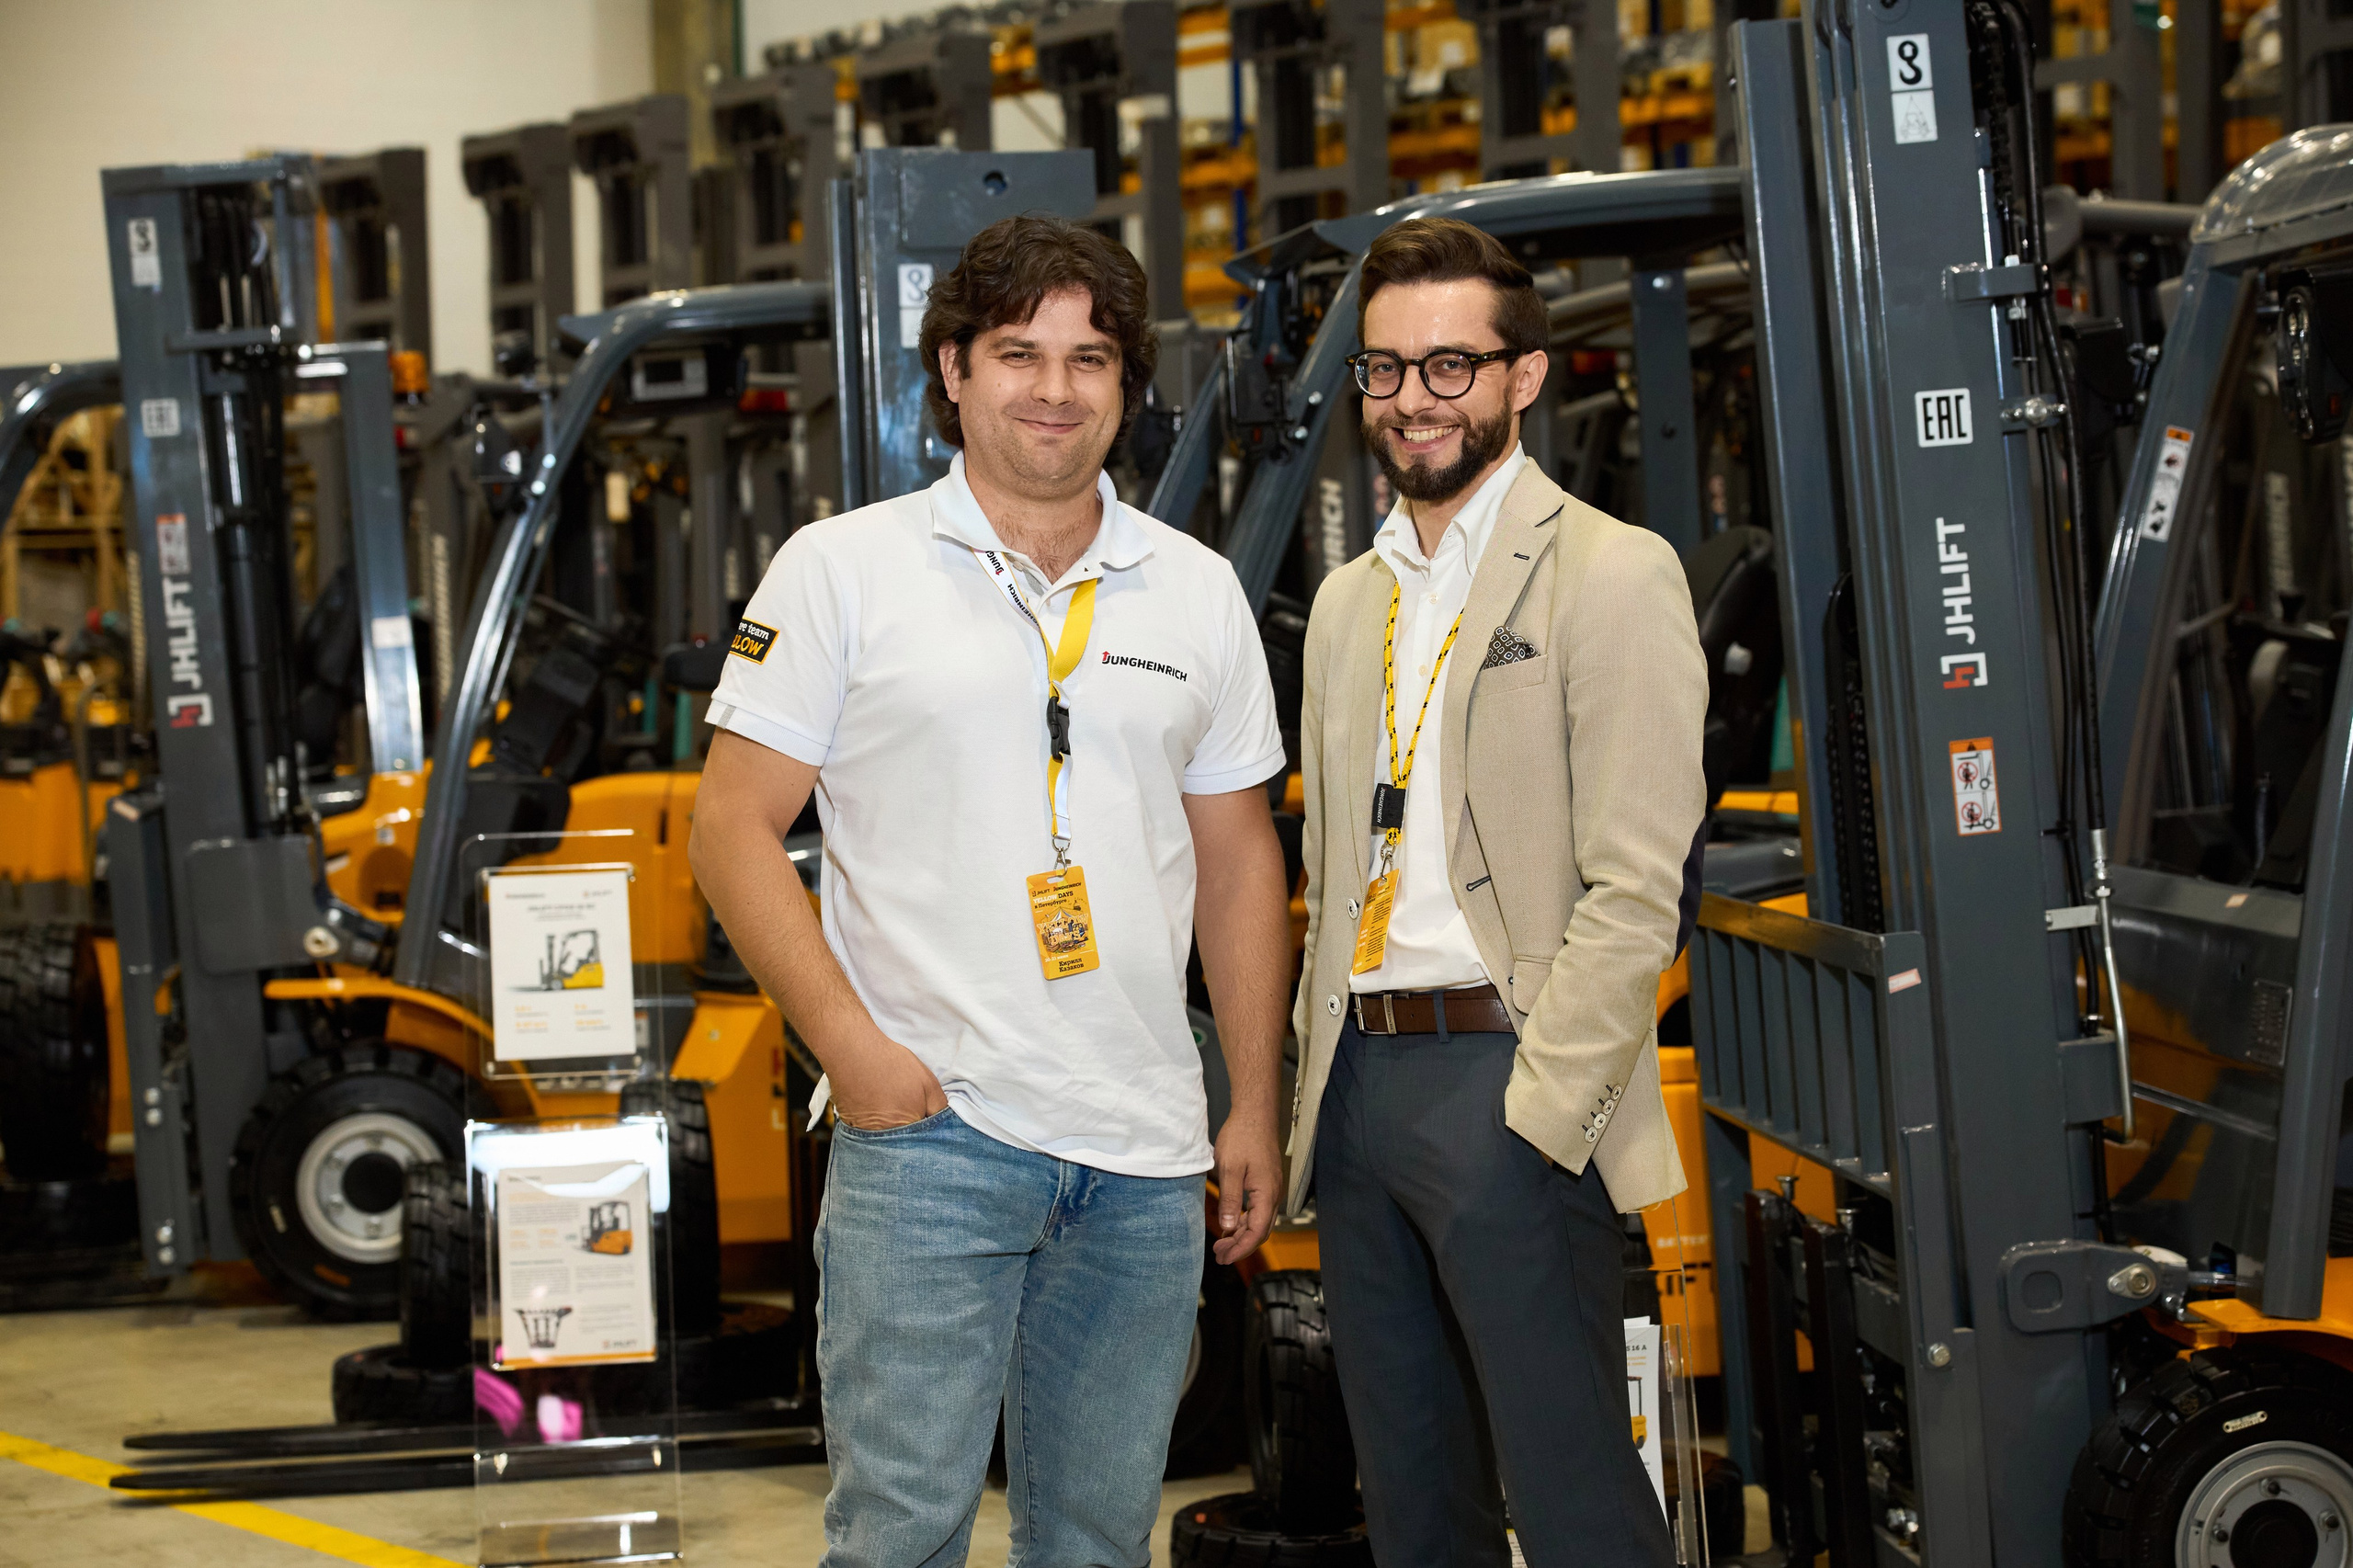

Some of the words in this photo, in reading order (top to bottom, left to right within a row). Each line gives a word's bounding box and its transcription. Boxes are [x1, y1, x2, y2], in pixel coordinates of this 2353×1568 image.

[1922, 395, 1967, 440] EAC
[1320, 478, 1347, 574] RICH
[1935, 517, 1976, 645] JHLIFT
[1007, 583, 1040, 627] GHEINRICH
[162, 575, 202, 690] JHLIFT
[747, 623, 770, 641] team
[1101, 651, 1188, 682] JUNGHEINRICH
[1033, 894, 1058, 904] YELLOW
[1058, 891, 1074, 899] DAYS
[1038, 899, 1067, 909] Петербурге
[1059, 959, 1082, 967] Кирилл
[1059, 963, 1085, 973] Казаков
